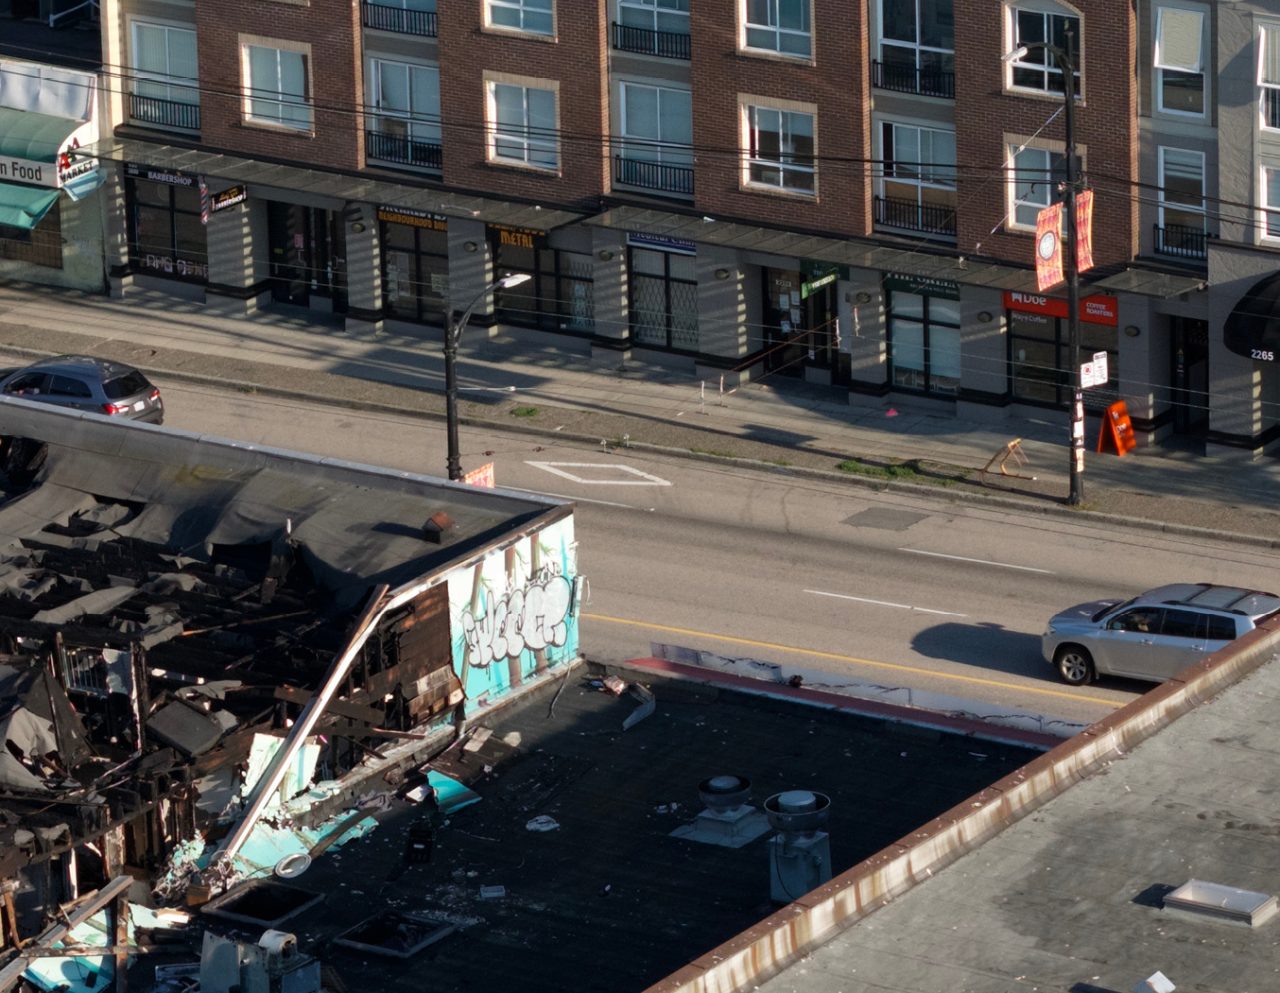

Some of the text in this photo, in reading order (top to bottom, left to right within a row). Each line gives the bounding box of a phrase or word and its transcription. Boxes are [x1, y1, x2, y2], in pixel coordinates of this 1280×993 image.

[12, 162, 42, 181] Food
[60, 160, 93, 182] MARKET
[147, 171, 192, 186] BARBERSHOP
[1251, 349, 1274, 361] 2265
